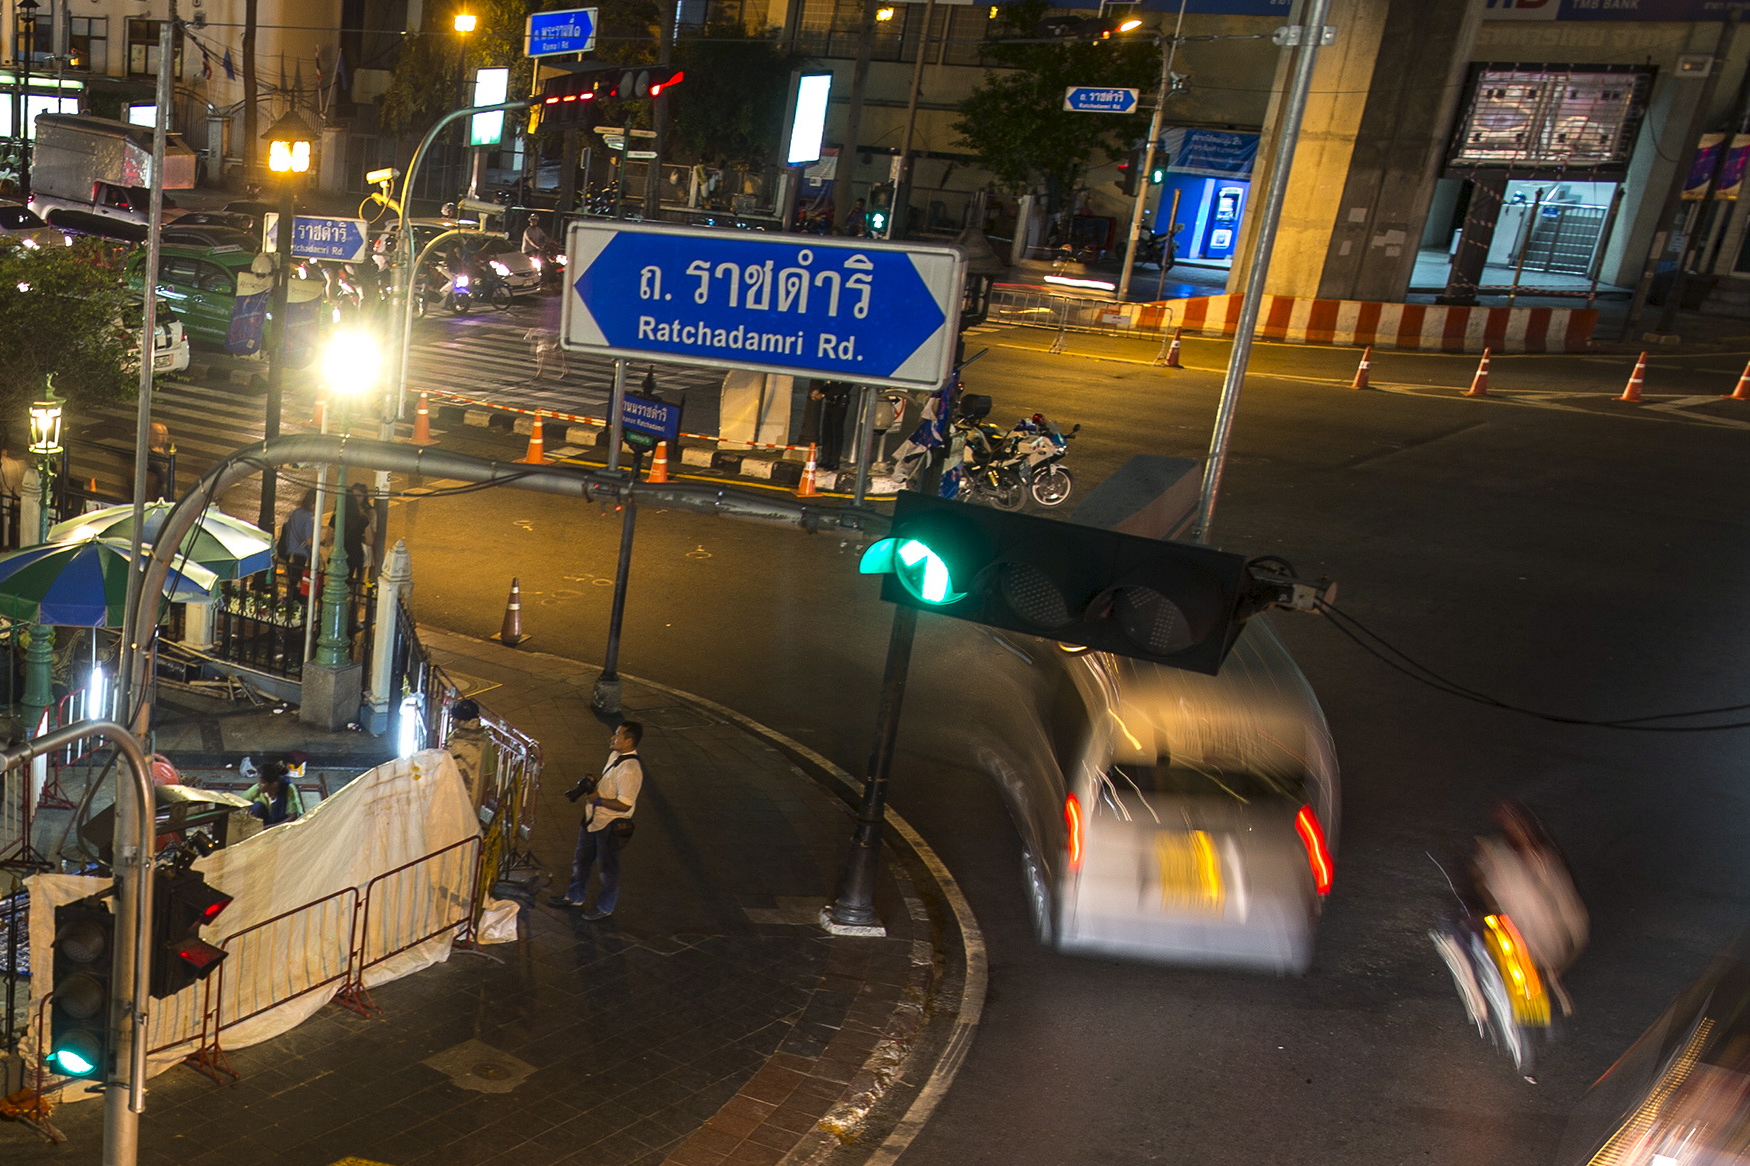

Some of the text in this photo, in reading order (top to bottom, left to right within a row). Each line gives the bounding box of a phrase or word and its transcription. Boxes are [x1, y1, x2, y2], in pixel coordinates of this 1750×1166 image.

[298, 221, 347, 242] ราชดำริ
[294, 244, 329, 255] tchadamri
[639, 248, 874, 319] ถ. ราชดำริ
[638, 316, 863, 361] Ratchadamri Rd.
